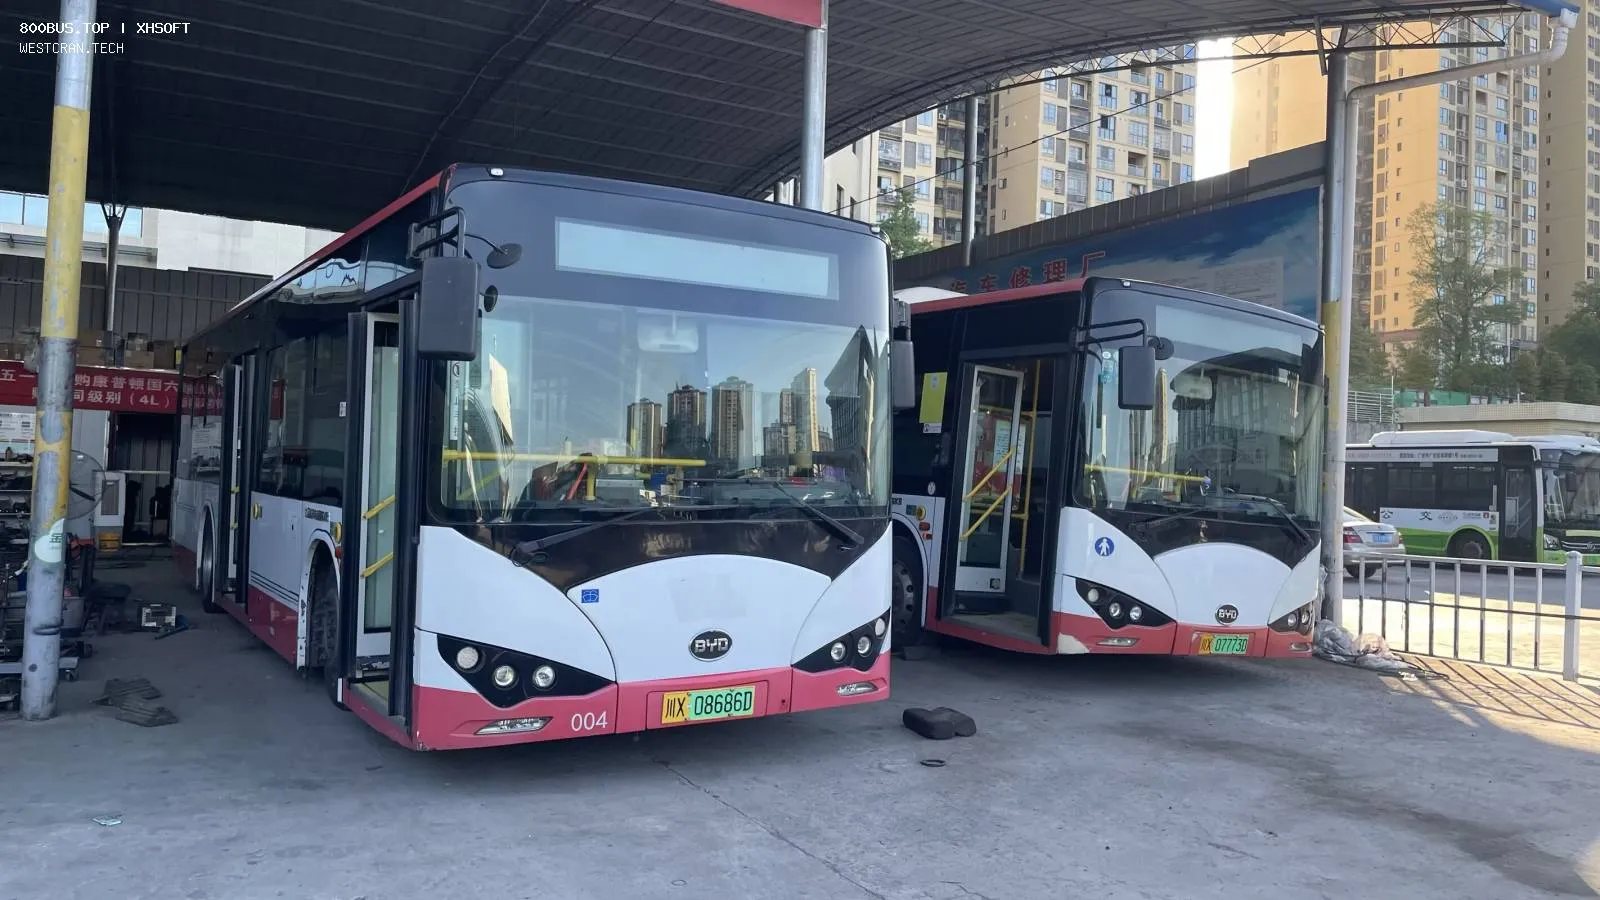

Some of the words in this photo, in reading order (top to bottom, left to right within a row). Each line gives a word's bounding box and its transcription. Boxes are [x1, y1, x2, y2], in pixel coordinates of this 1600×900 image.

[1218, 609, 1237, 619] BYD
[693, 637, 729, 653] BYD
[693, 690, 753, 716] 08686D
[571, 711, 608, 732] 004
